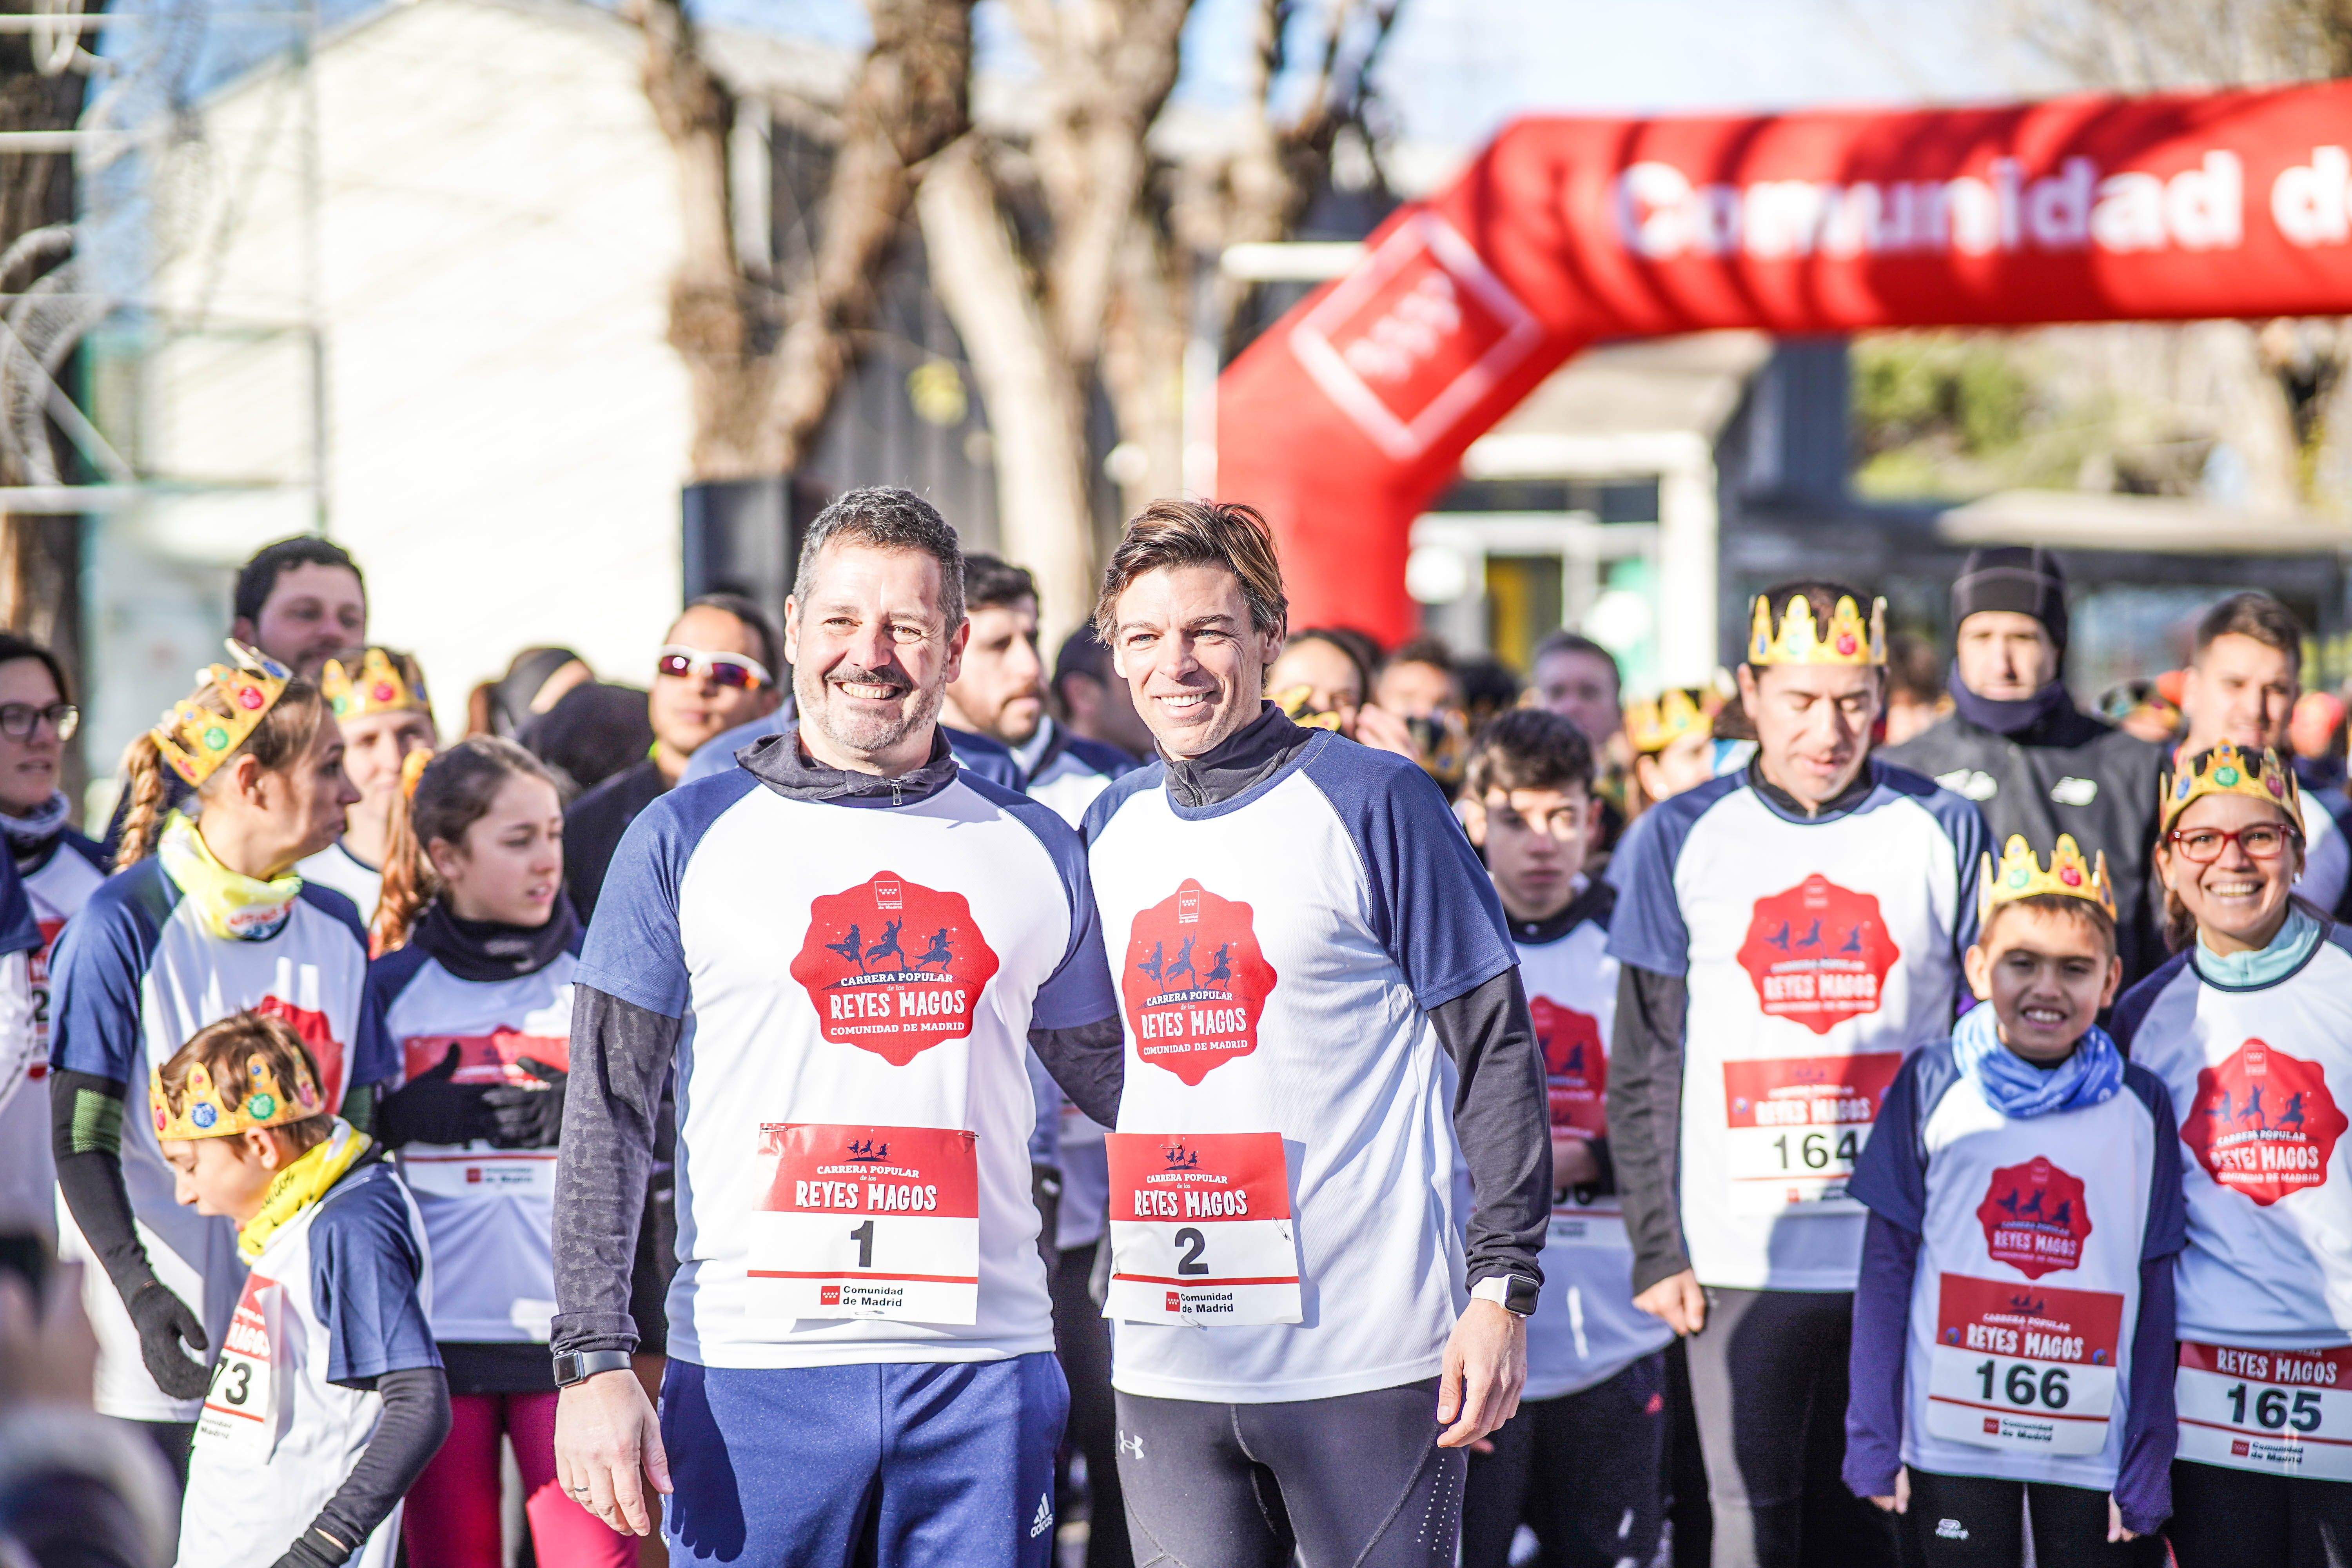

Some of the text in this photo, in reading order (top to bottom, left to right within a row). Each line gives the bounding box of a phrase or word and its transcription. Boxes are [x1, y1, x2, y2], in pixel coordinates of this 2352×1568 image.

[1616, 144, 2352, 260] Comunidad d
[840, 972, 953, 987] CARRERA POPULAR
[830, 989, 966, 1020] REYES MAGOS
[1147, 991, 1232, 1007] CARRERA POPULAR
[830, 1022, 965, 1036] COMUNIDAD DE MADRID
[1141, 1007, 1247, 1040] REYES MAGOS
[1143, 1040, 1248, 1055] COMUNIDAD DE MADRID
[2259, 1130, 2307, 1143] POPULAR
[1773, 1130, 1858, 1169] 164
[2261, 1145, 2319, 1171] MAGOS
[817, 1165, 919, 1179] CARRERA POPULAR
[1147, 1173, 1228, 1184] CARRERA POPULAR
[2280, 1172, 2320, 1183] MADRID
[795, 1180, 938, 1212] REYES MAGOS
[1134, 1189, 1247, 1218] REYES MAGOS
[850, 1220, 874, 1268] 1
[1174, 1227, 1209, 1275] 2
[843, 1286, 903, 1296] Comunidad
[1181, 1293, 1233, 1301] Comunidad
[843, 1297, 902, 1307] de Madrid
[1182, 1303, 1234, 1313] de Madrid
[1966, 1323, 2084, 1361] REYES MAGOS
[2217, 1348, 2337, 1385] REYES MAGOS
[1976, 1359, 2070, 1409] 166
[2227, 1382, 2322, 1432] 165
[2003, 1418, 2053, 1430] Comunidad
[2017, 1430, 2052, 1441] Madrid
[2252, 1441, 2303, 1454] Comunidad
[2251, 1451, 2302, 1464] de Madrid
[1030, 1513, 1053, 1538] adidas
